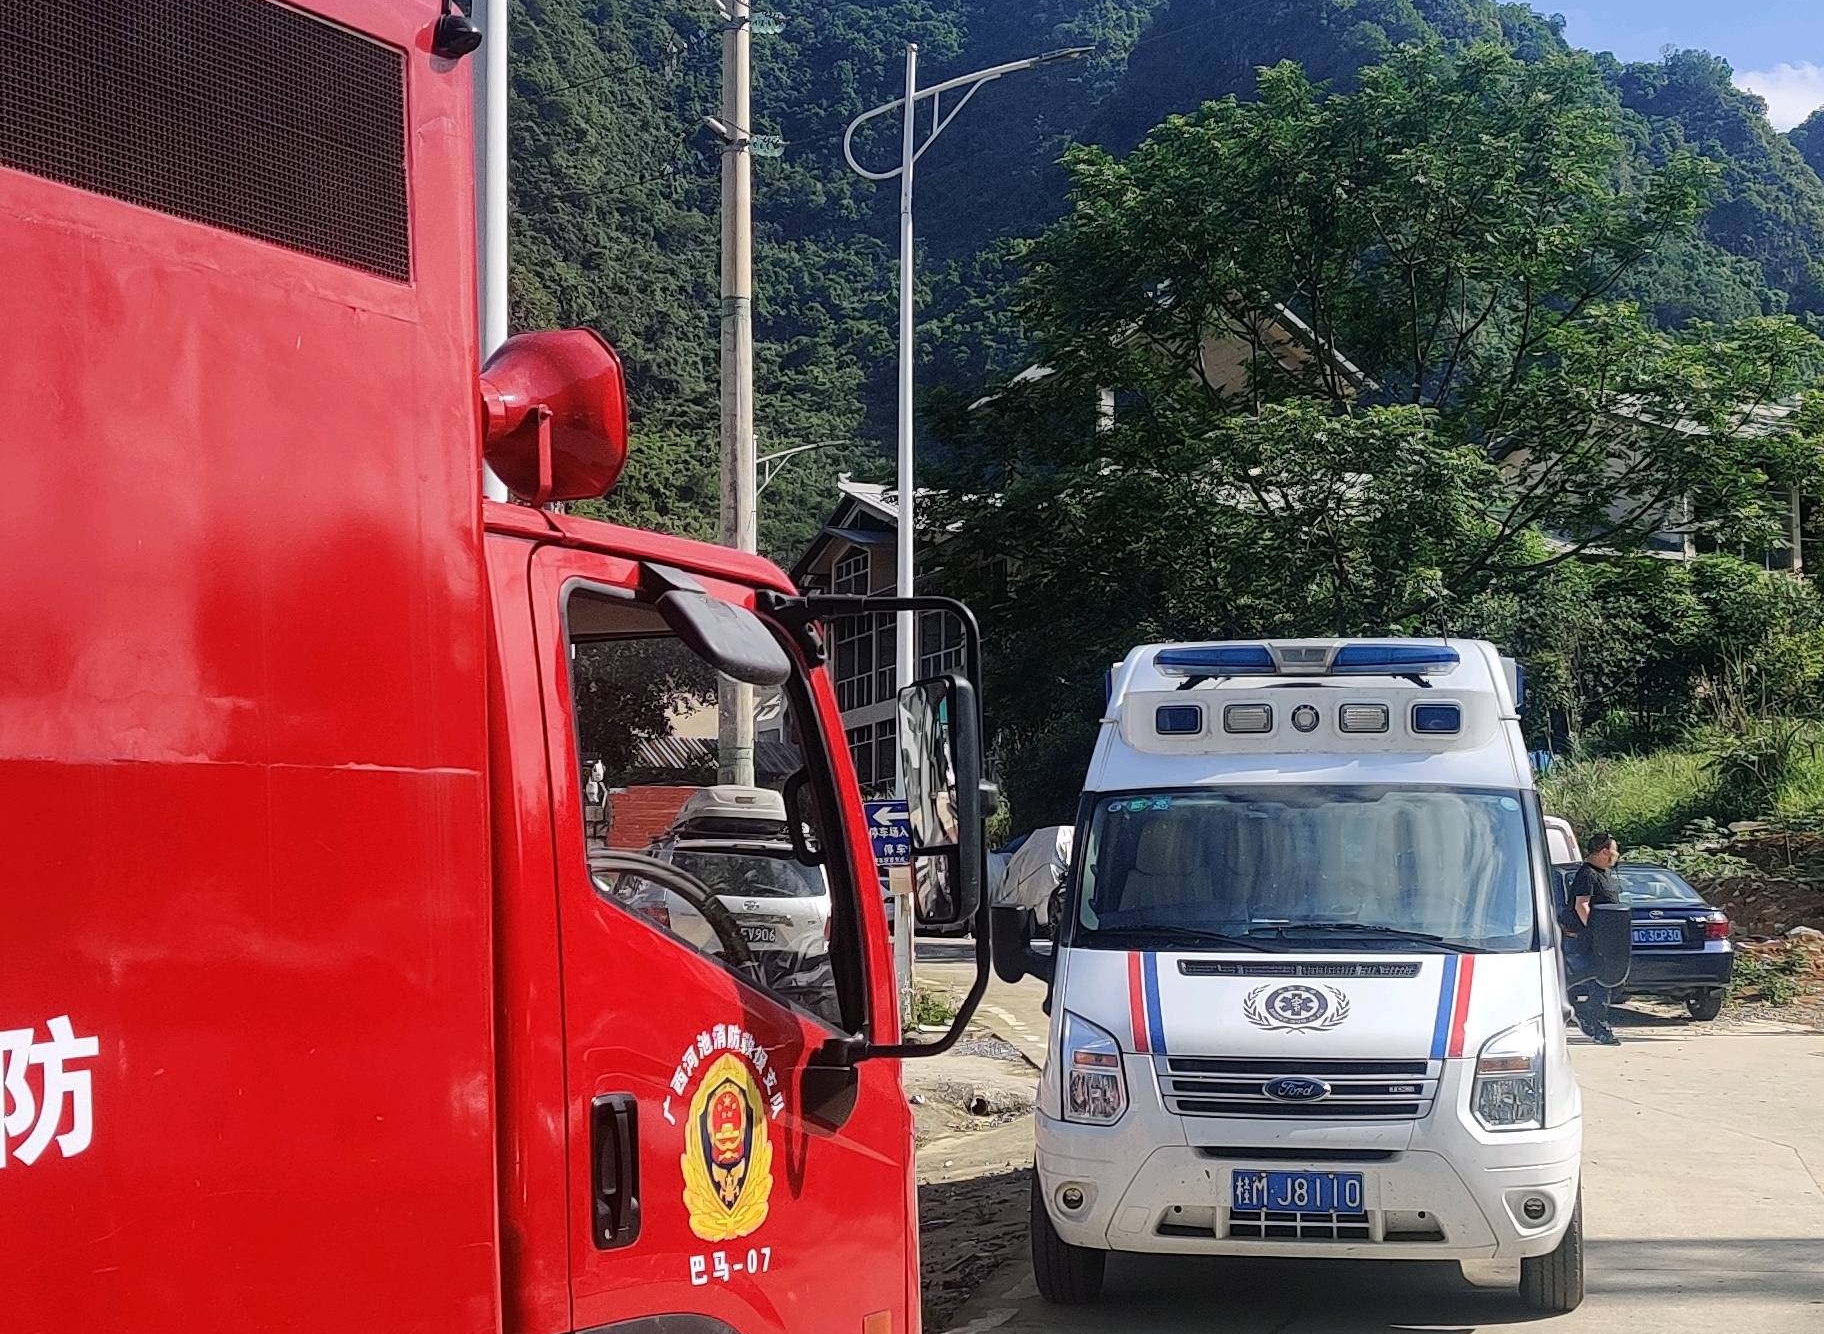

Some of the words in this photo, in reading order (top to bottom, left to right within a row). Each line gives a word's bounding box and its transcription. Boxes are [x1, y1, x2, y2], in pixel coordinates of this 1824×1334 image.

[884, 843, 911, 857] 停车
[0, 1014, 100, 1168] 防
[662, 1022, 785, 1126] 广西河池消防救援支队
[1277, 1079, 1315, 1097] Ford
[689, 1246, 772, 1287] 巴马-07
